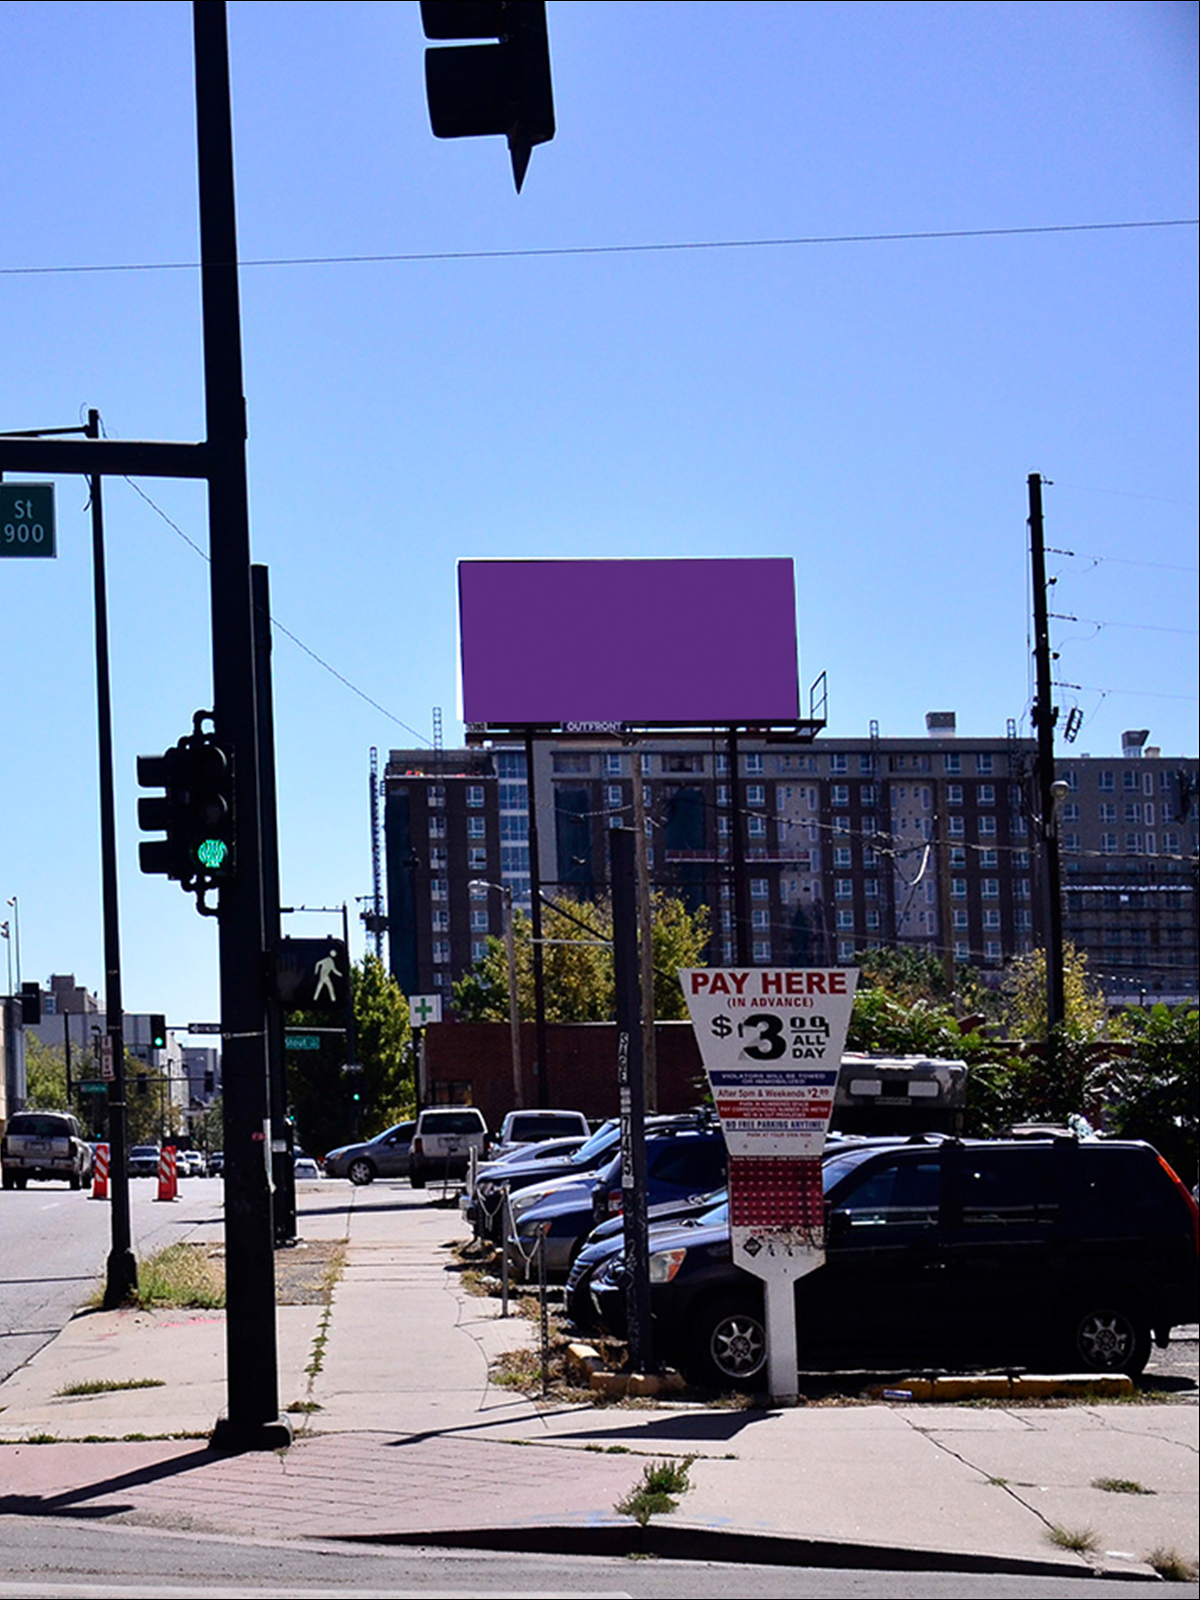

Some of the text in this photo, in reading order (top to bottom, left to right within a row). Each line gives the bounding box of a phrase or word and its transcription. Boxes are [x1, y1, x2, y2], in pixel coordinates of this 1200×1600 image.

[14, 500, 33, 519] St
[4, 524, 45, 543] 900
[566, 721, 623, 732] OUTFRONT
[691, 972, 847, 995] PAY HERE
[727, 998, 814, 1008] (IN ADVANCE)
[793, 1035, 826, 1046] ALL
[792, 1048, 826, 1059] DAY
[718, 1089, 736, 1098] After
[765, 1089, 805, 1098] Weekends
[726, 1121, 736, 1129] NO
[738, 1121, 755, 1129] FREE
[757, 1121, 788, 1129] PARKING
